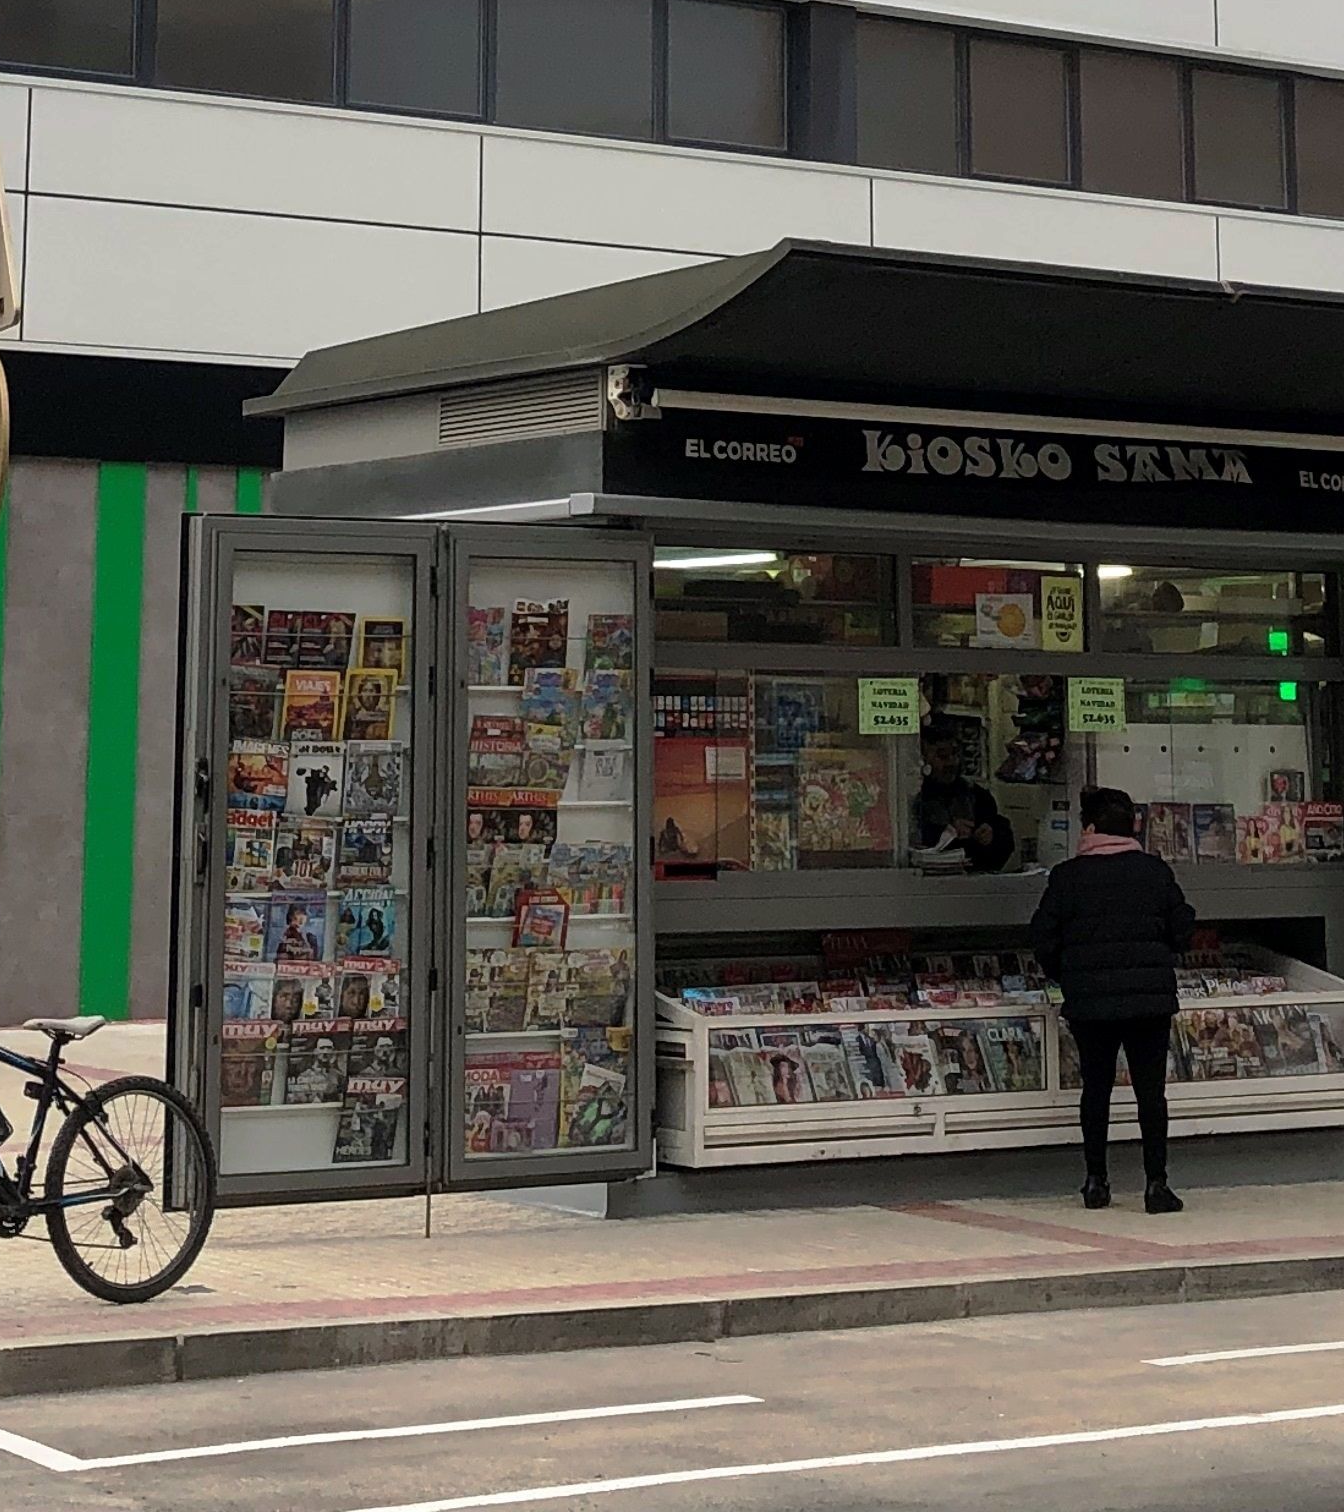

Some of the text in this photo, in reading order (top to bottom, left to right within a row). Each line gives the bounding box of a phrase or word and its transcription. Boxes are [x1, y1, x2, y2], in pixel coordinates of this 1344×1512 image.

[685, 438, 711, 458] EL
[713, 440, 797, 463] CORREO
[1298, 470, 1319, 489] EL
[871, 701, 910, 709] NAVIDAD
[293, 1019, 336, 1034] muy
[353, 1018, 396, 1033] muy
[348, 1079, 404, 1094] muy
